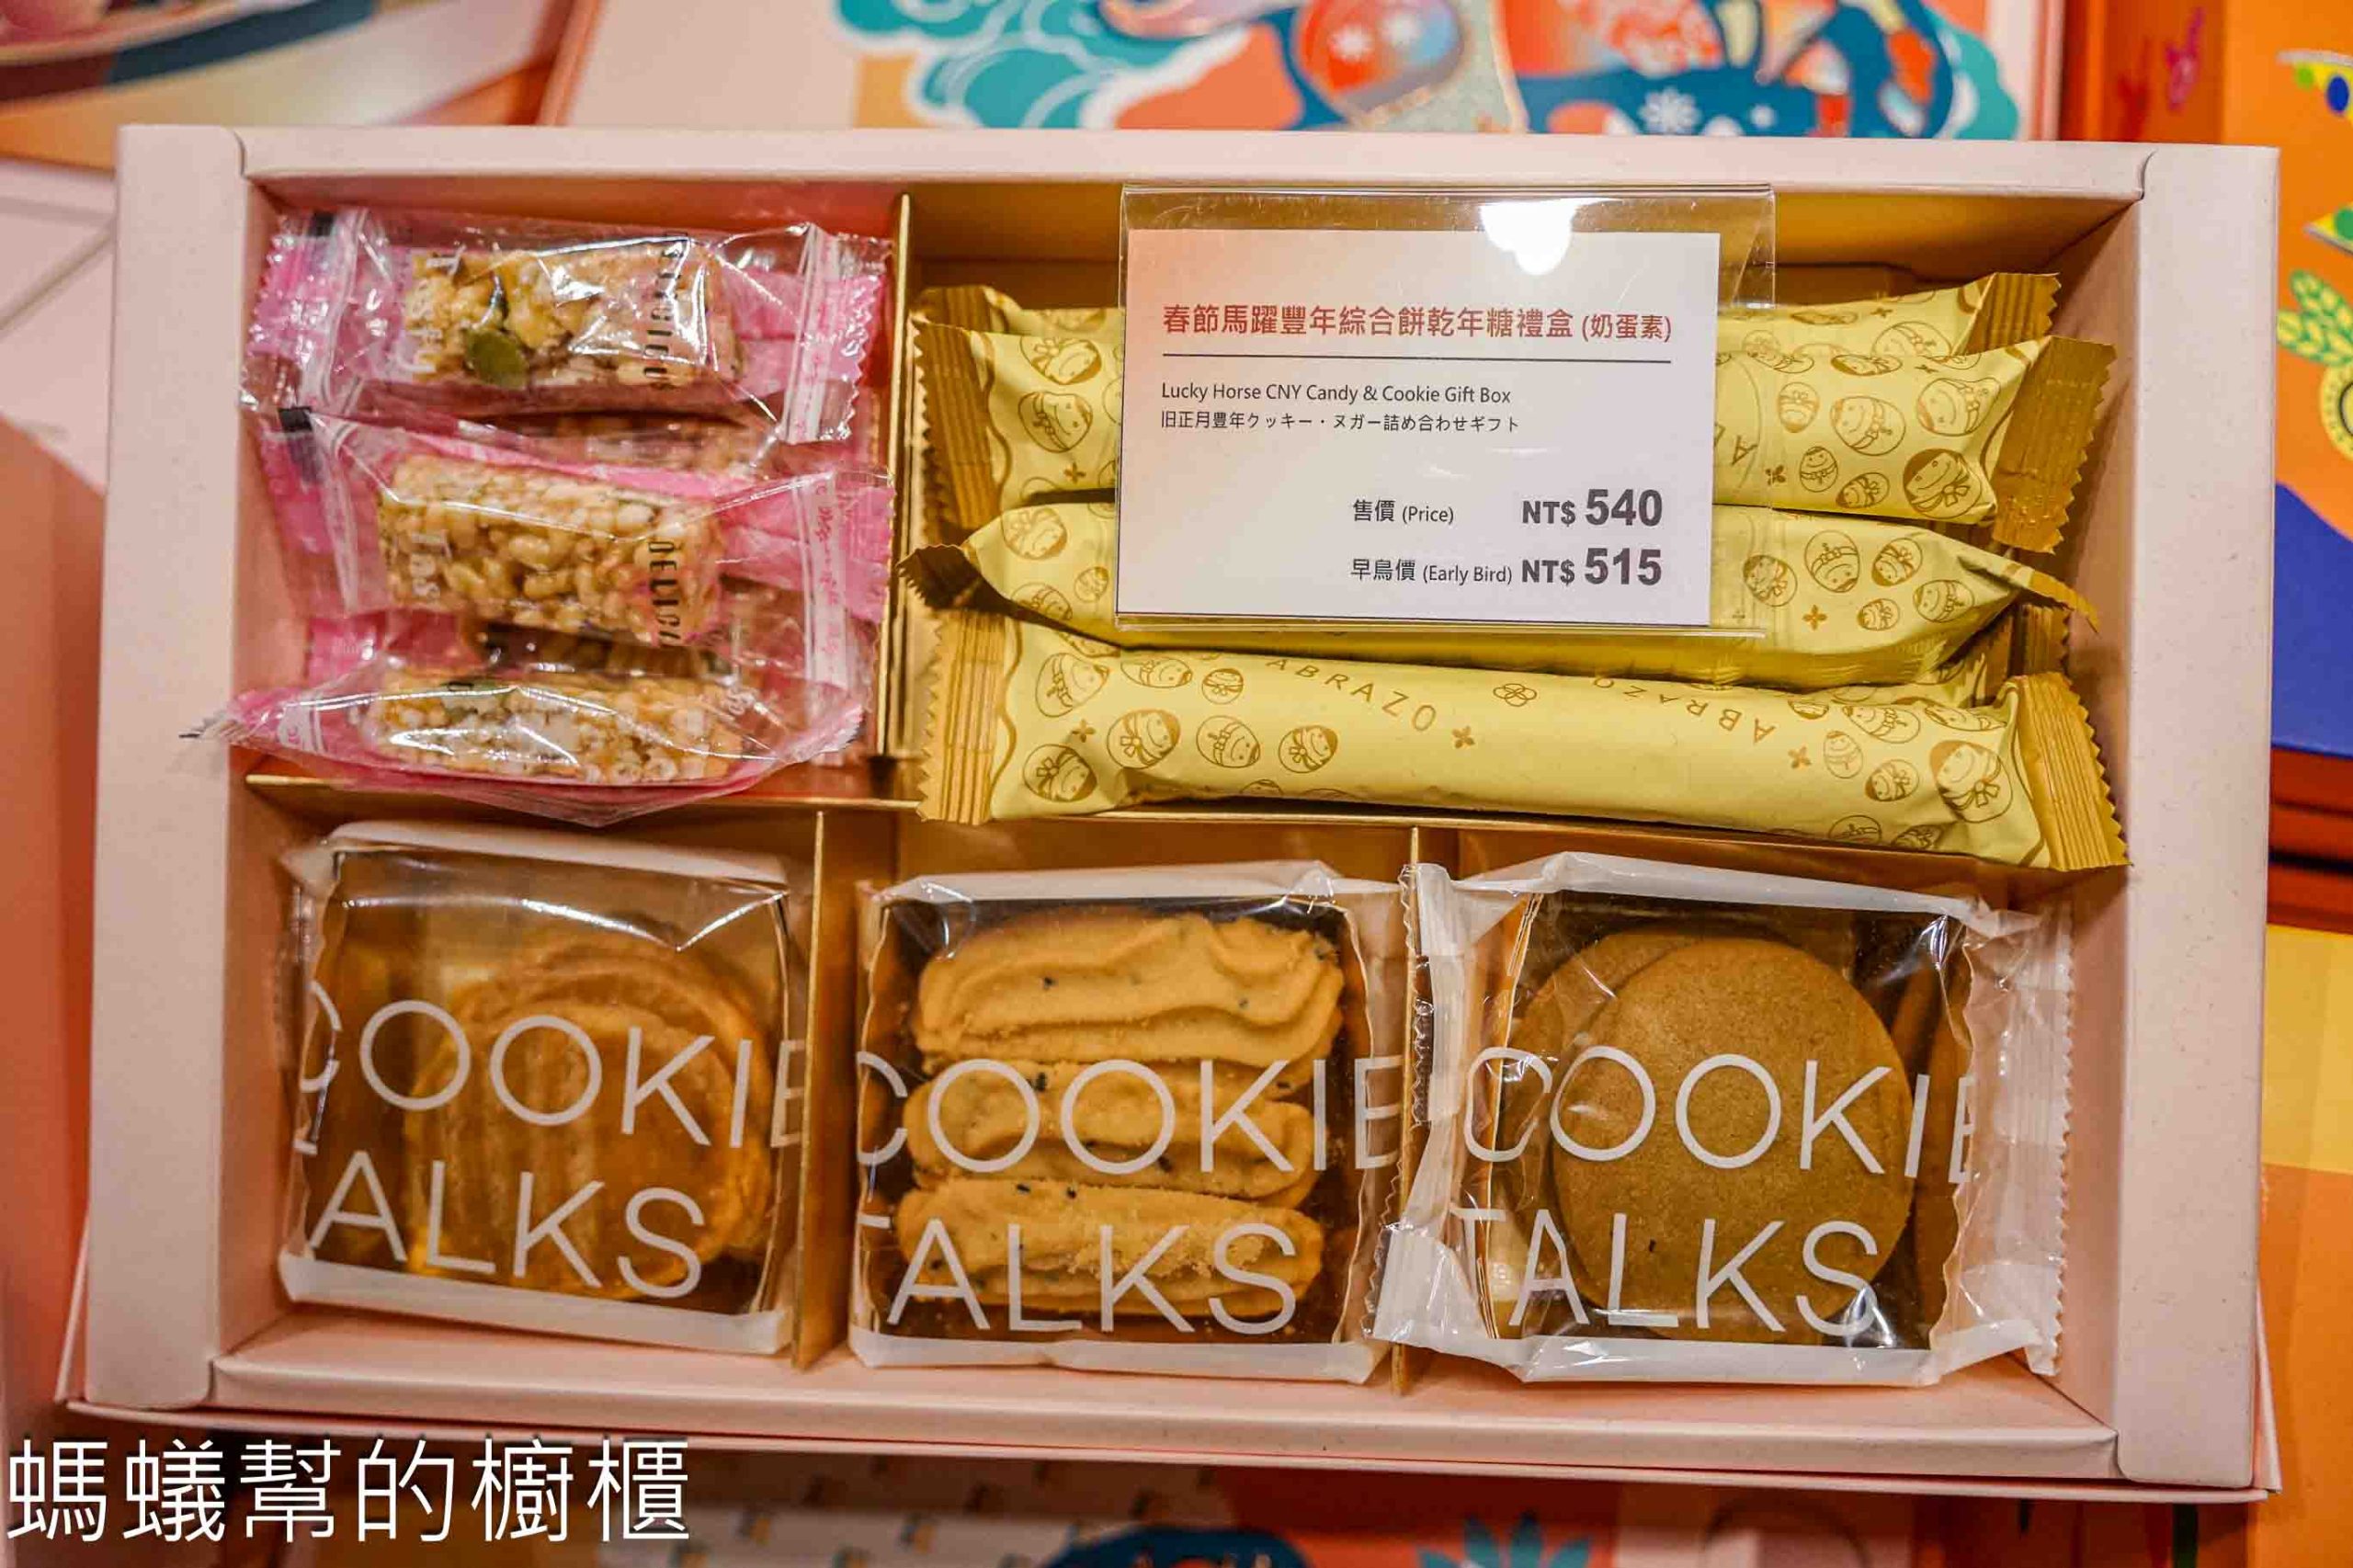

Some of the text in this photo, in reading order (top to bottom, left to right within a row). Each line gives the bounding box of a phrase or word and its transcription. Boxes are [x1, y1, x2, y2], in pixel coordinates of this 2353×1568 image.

[1163, 304, 1672, 343] 春節馬躍豐年綜合餅乾年糖禮盒 (奶蛋素)
[1161, 381, 1511, 404] Lucky Horse CNY Candy & Cookie Gift Box
[1352, 488, 1664, 527] 售價 (Price) NT$ 540
[1350, 547, 1663, 586] 早鳥價 (Early Bird) NT$ 515
[1265, 657, 1438, 732] ABRAZO
[1593, 676, 1777, 744] ABRAZO
[294, 1138, 705, 1300] ALKS
[857, 1214, 1297, 1335] ALKS
